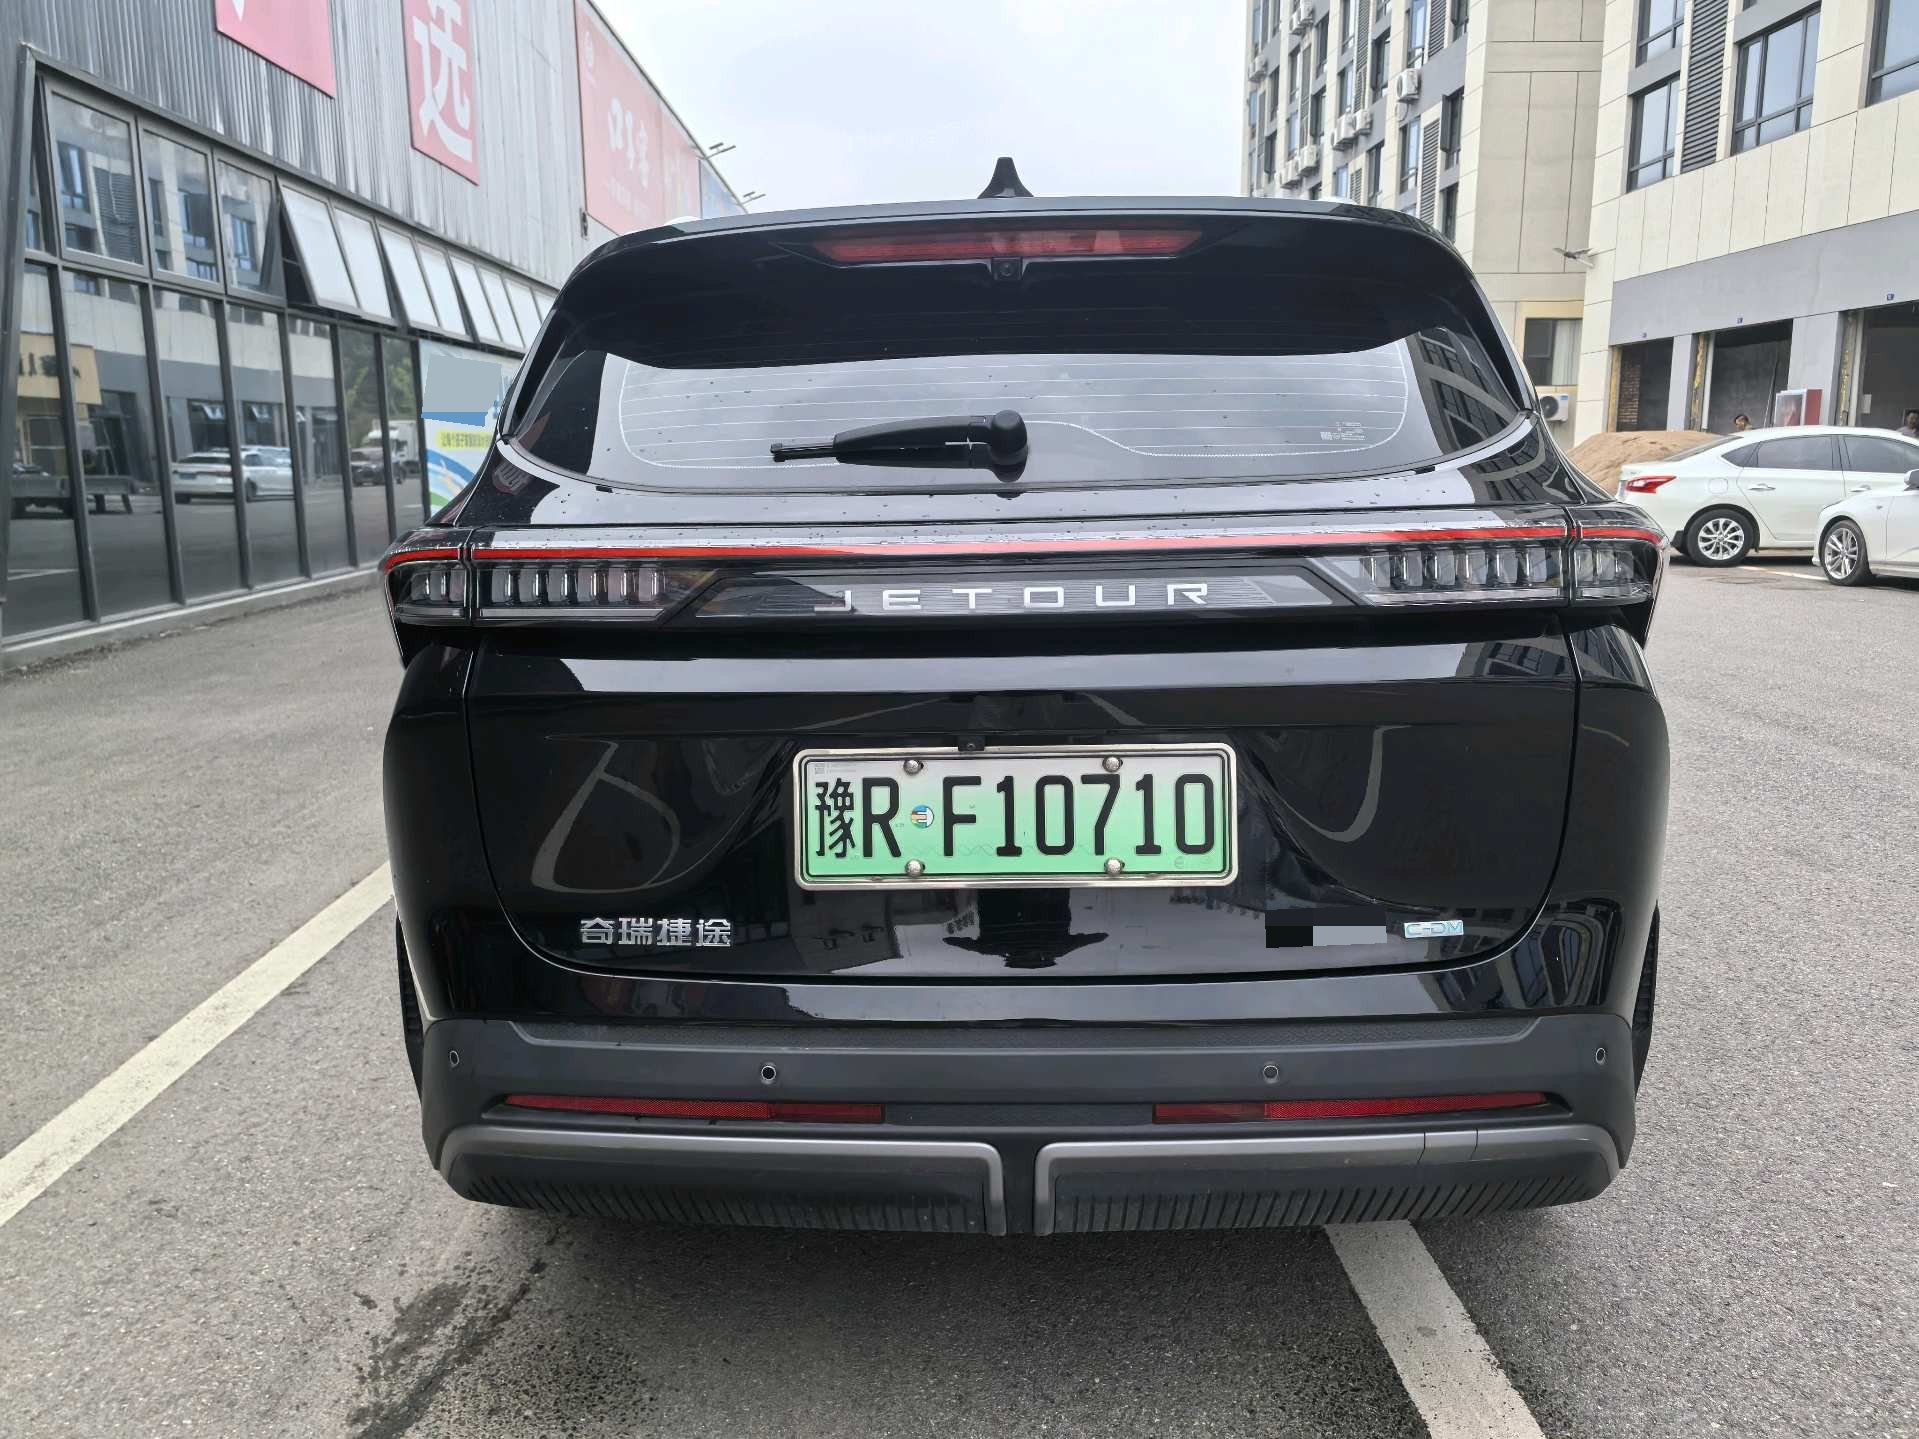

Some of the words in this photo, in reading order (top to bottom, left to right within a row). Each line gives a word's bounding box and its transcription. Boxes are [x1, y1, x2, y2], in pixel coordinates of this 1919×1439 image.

[813, 583, 1208, 612] JETOUR
[579, 917, 731, 947] 奇瑞捷途
